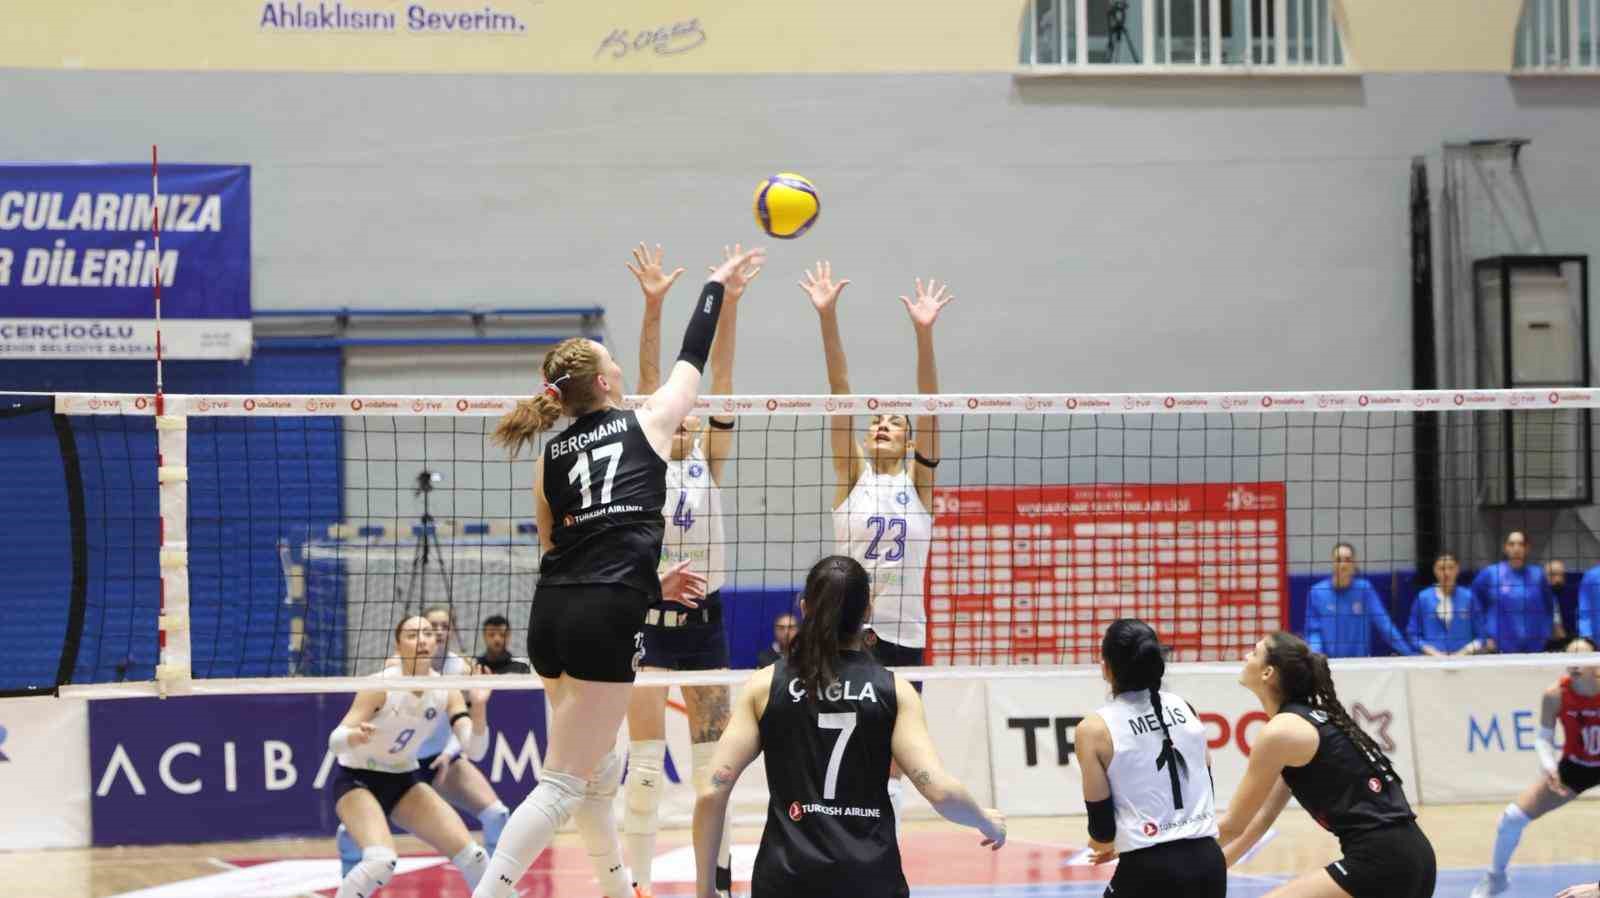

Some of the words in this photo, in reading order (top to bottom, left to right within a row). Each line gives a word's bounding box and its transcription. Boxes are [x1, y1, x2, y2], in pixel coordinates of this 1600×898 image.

[260, 2, 395, 32] Ahlaklısını
[407, 5, 526, 33] Severim.
[0, 192, 221, 231] CULARIMIZA
[22, 240, 178, 287] DİLERİM
[1, 324, 133, 340] ÇERÇİOĞLU
[256, 400, 292, 409] vodafone
[364, 400, 399, 409] vodafone
[469, 400, 504, 409] vodafone
[779, 400, 812, 408] vodafone
[880, 400, 912, 408] vodafone
[980, 399, 1012, 407] vodafone
[1078, 399, 1111, 407] vodafone
[1177, 398, 1208, 406] vodafone
[1274, 398, 1304, 406] vodafone
[551, 418, 628, 460] BERGMANN
[568, 441, 624, 509] 17
[673, 486, 695, 533] 4
[864, 516, 907, 561] 23
[788, 676, 877, 703] ÇĞLA
[1127, 706, 1187, 736] MELİS
[388, 728, 416, 754] 9
[817, 712, 857, 800] 7
[801, 804, 842, 816] TURKISH
